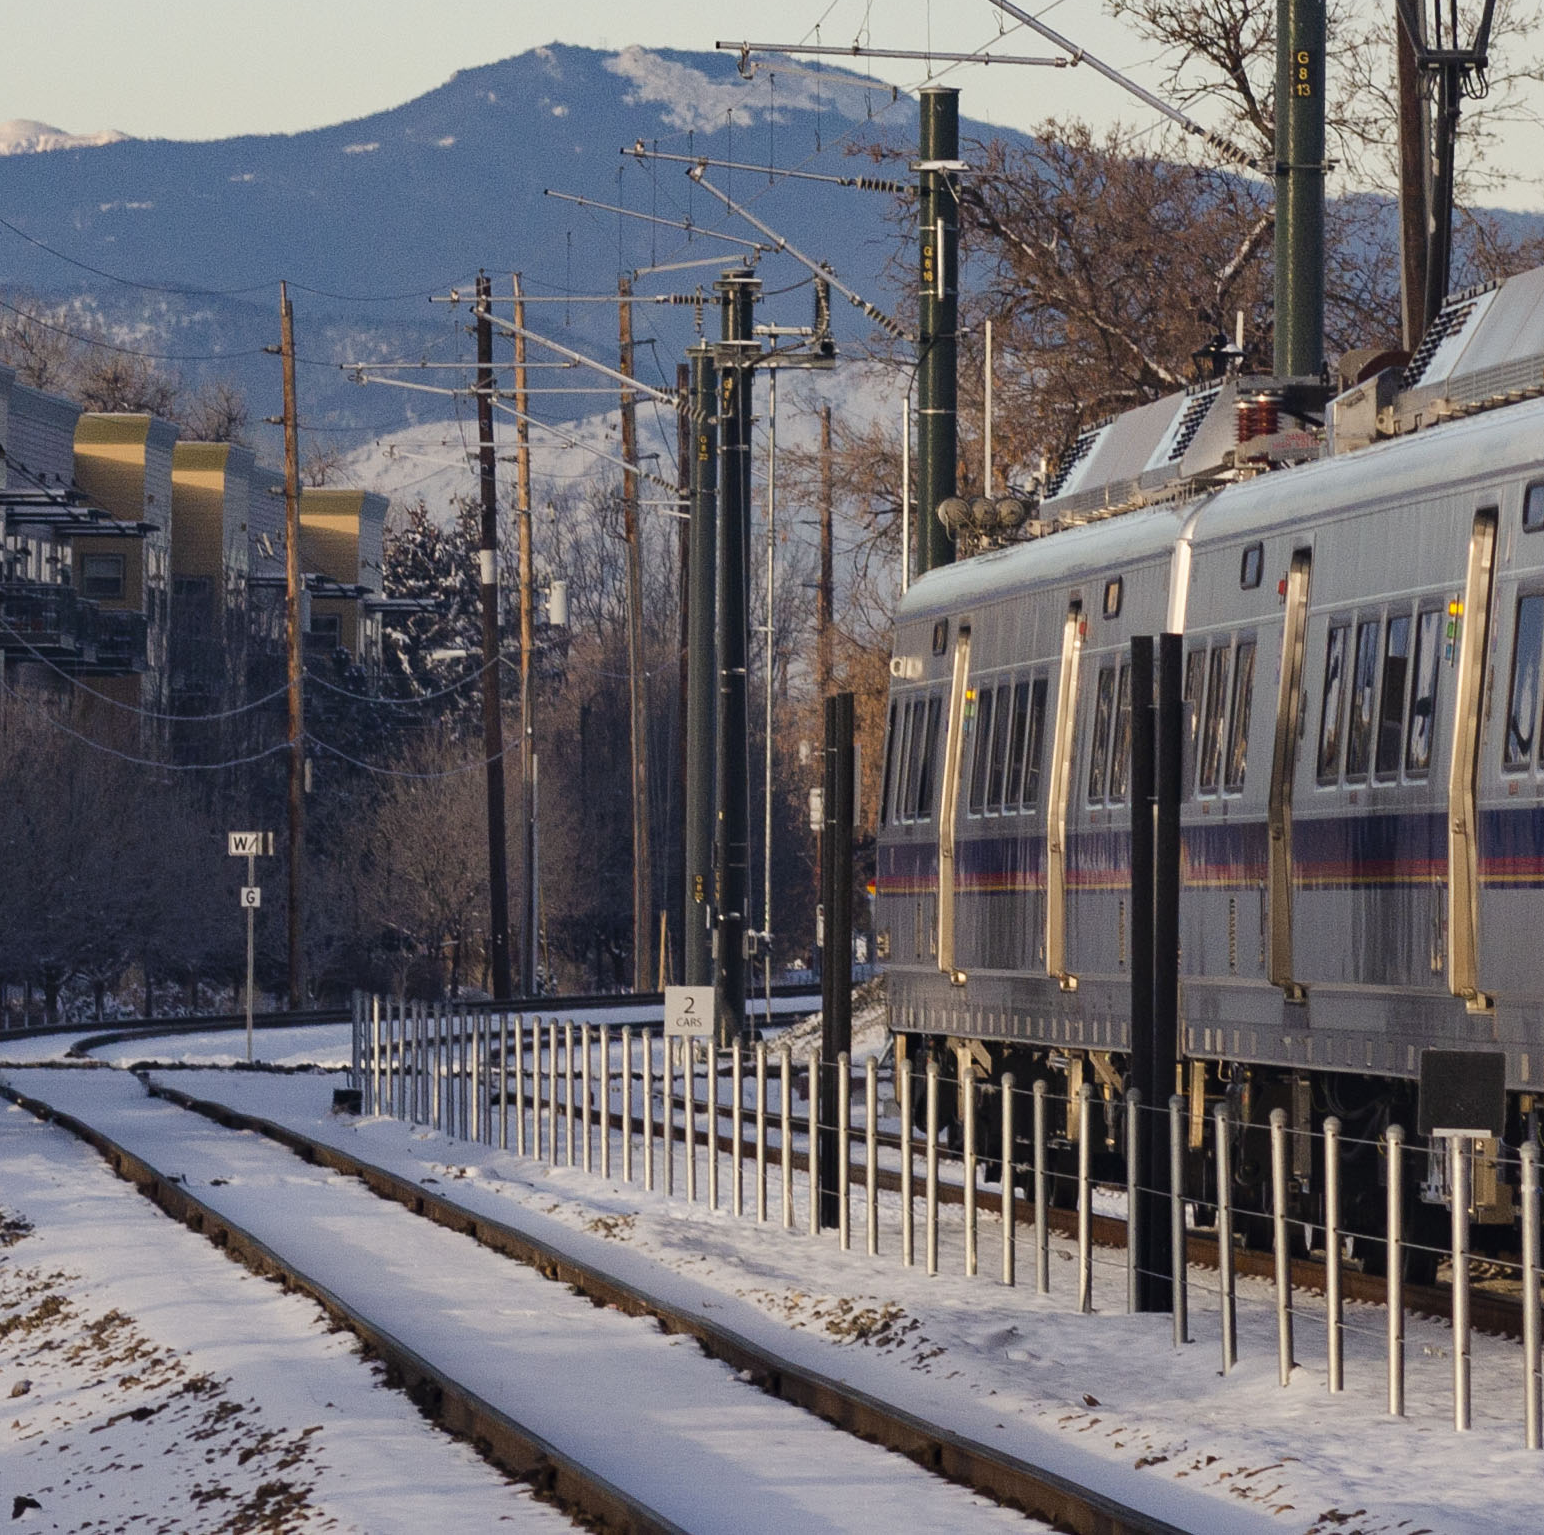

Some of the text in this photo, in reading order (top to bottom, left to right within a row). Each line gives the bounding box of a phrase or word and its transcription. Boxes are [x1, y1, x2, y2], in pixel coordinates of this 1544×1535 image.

[1297, 51, 1309, 64] G
[1299, 67, 1308, 80] 8
[1296, 83, 1311, 96] 13
[246, 890, 256, 904] G
[684, 996, 695, 1014] 2
[676, 1017, 703, 1027] CARS
